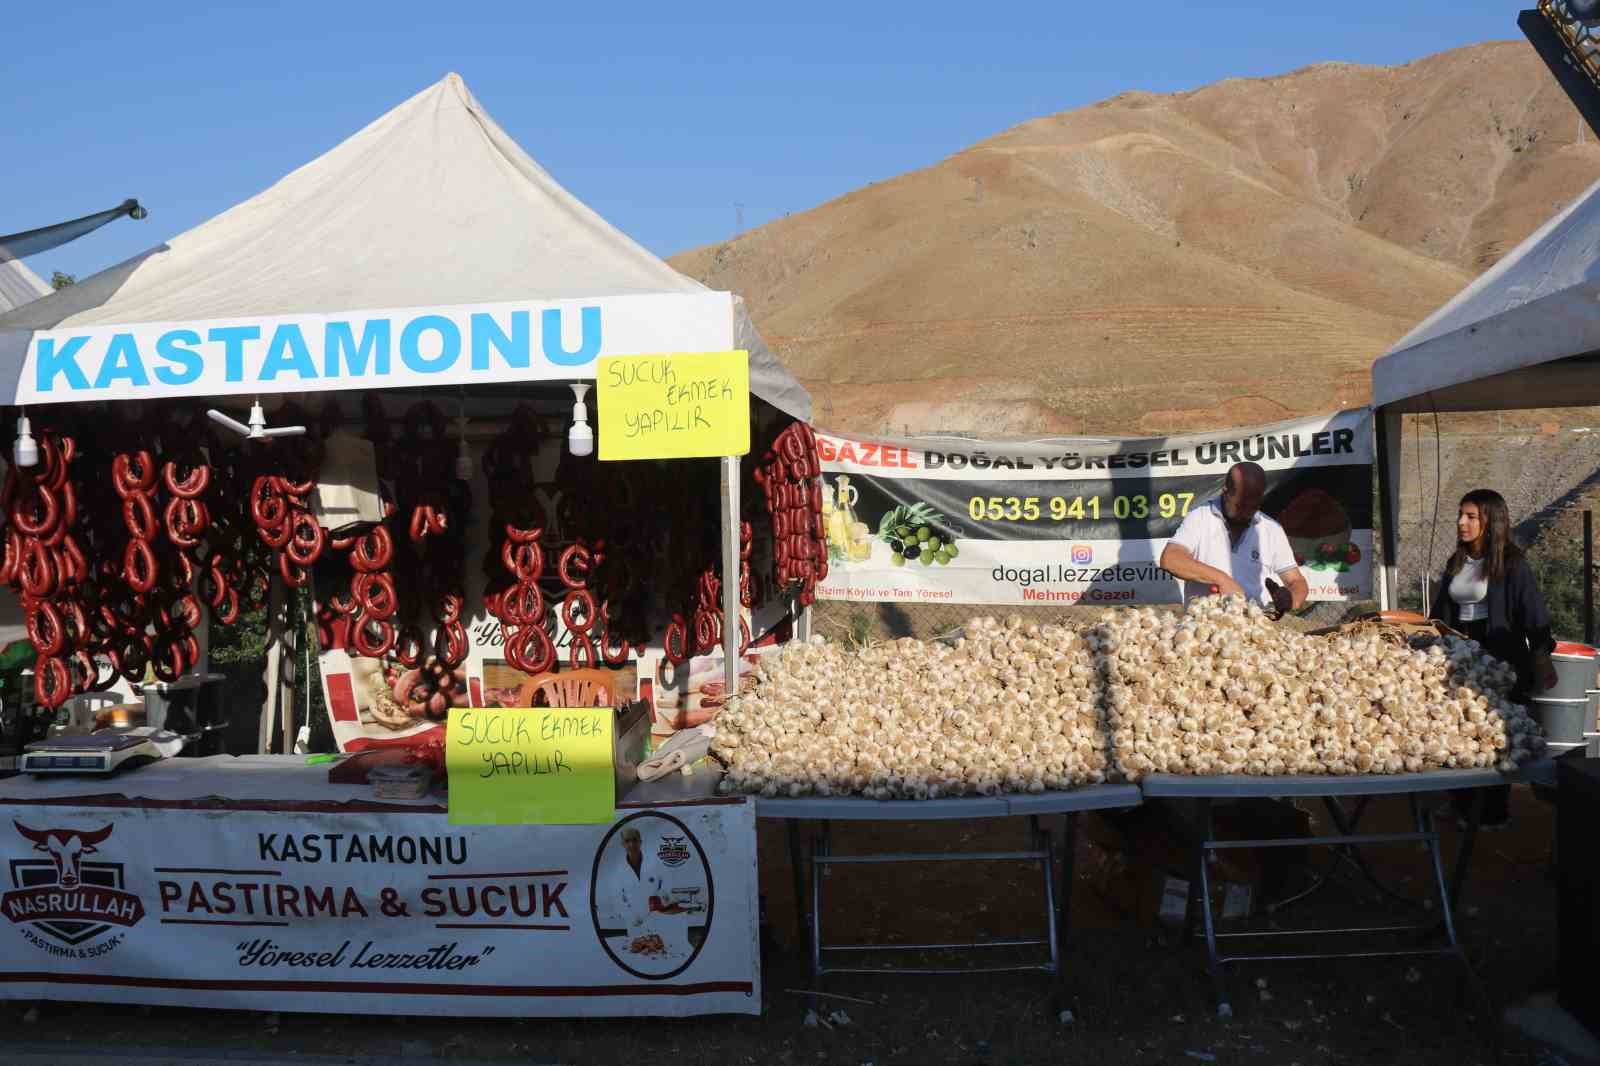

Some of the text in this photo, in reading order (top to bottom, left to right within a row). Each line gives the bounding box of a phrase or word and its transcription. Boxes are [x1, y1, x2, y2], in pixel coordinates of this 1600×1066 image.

[35, 306, 602, 392] KASTAMONU
[608, 360, 676, 388] SUCUK
[667, 378, 733, 406] EKMEK
[625, 406, 712, 437] YAPILIR
[816, 427, 1354, 471] GAZEL DOĞAL YÖRESEL ÜRÜNLER
[968, 492, 1195, 521] 0535 941 03 97
[1023, 588, 1135, 601] Mehmet Gazel
[458, 712, 602, 745] SUCUK EKMEK
[480, 750, 572, 778] YAPILIR
[258, 833, 467, 864] KASTAMONU
[8, 892, 136, 921] NASRULLAH
[159, 881, 569, 917] PASTIRMA & SUCUK
